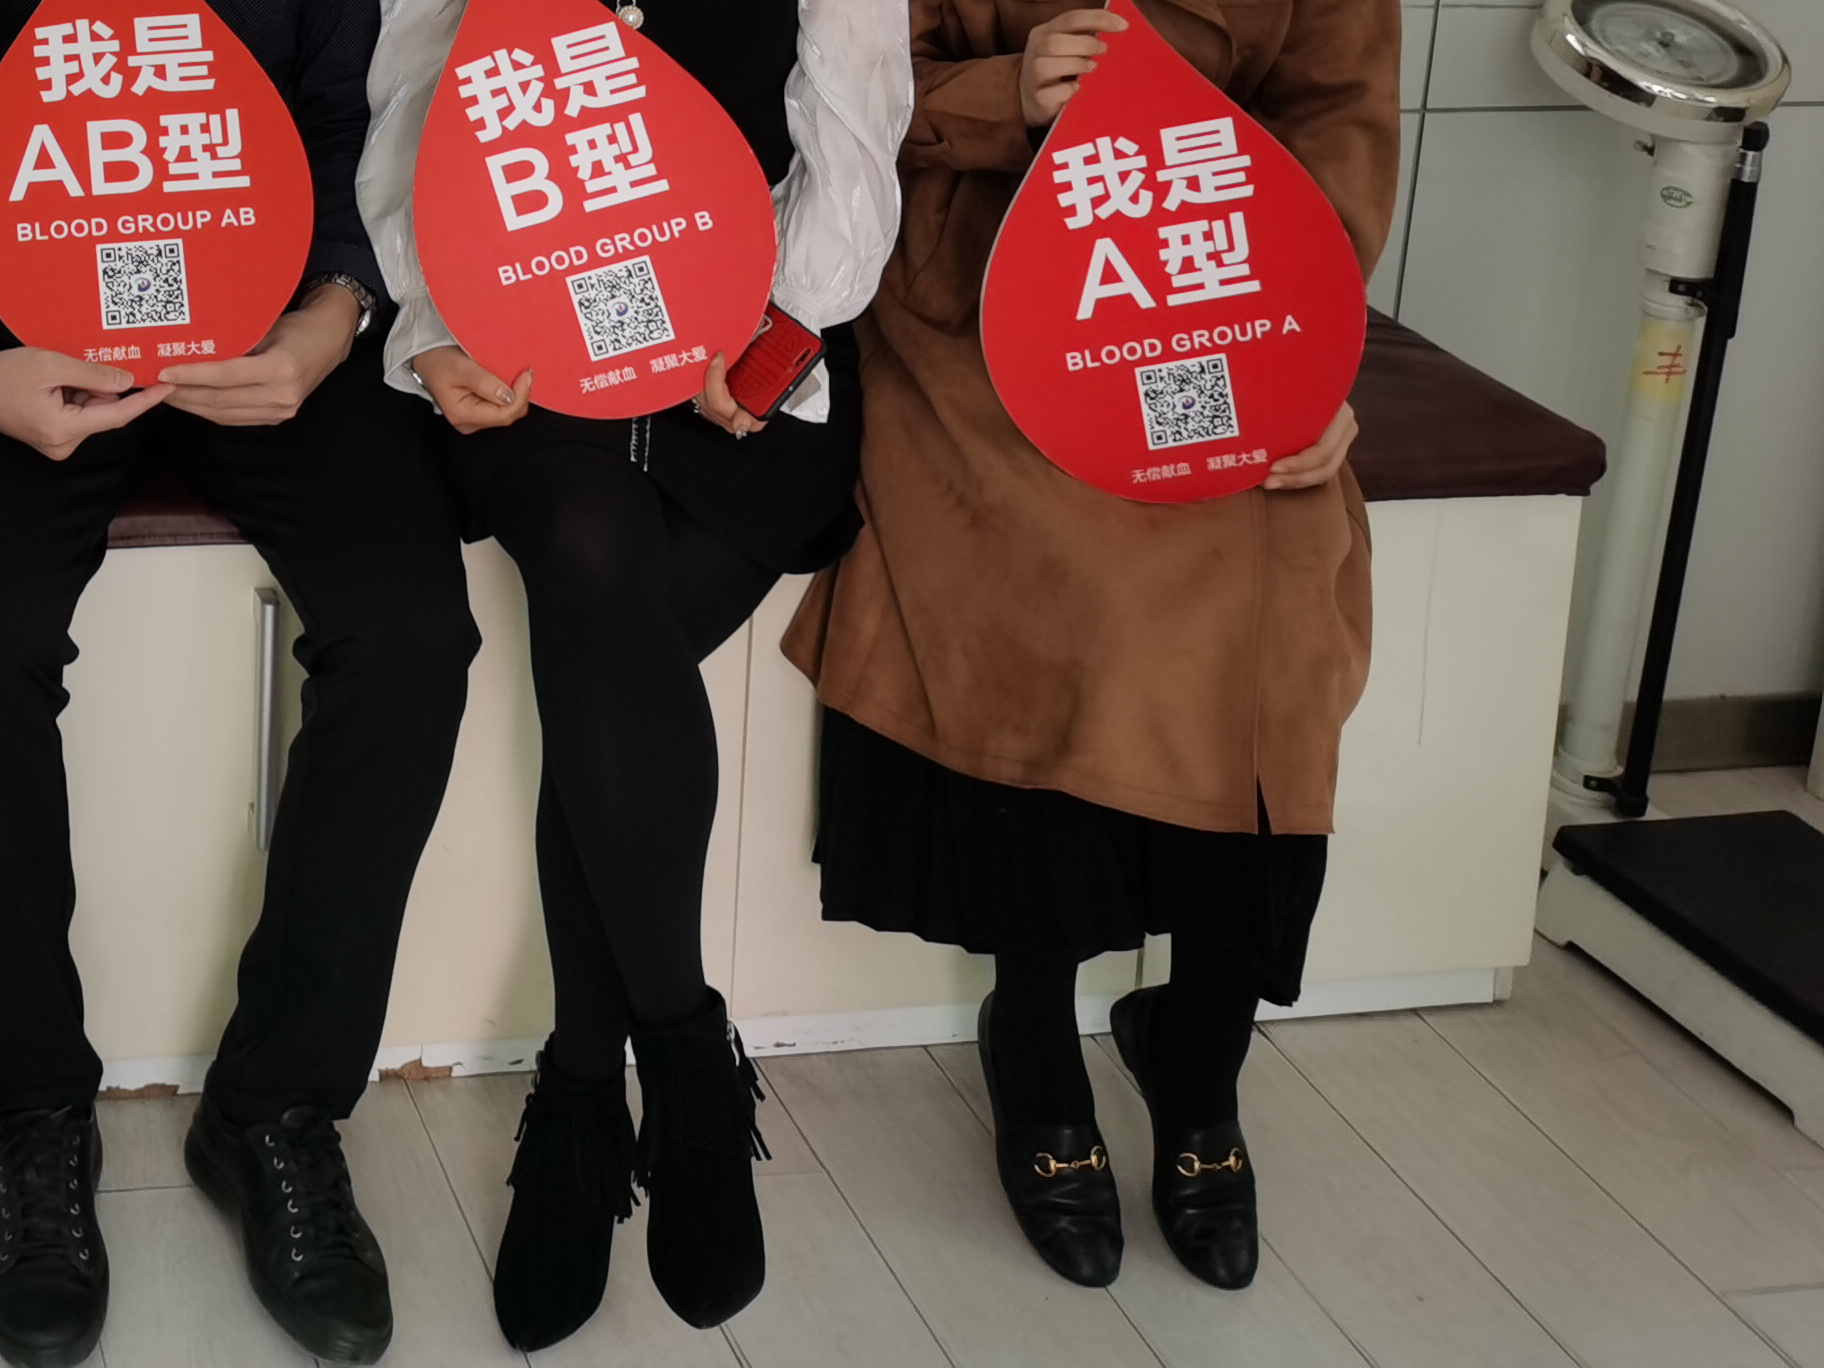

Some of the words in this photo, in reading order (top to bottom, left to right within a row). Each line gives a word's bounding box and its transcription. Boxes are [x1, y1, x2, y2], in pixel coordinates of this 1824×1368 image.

[32, 13, 216, 103] 我是
[454, 21, 647, 144] 我是
[8, 108, 251, 202] AB型
[1052, 116, 1255, 230] 我是
[16, 216, 109, 242] BLOOD
[116, 209, 212, 235] GROUP
[220, 207, 257, 228] AB
[496, 245, 589, 286] BLOOD
[595, 218, 688, 259] GROUP
[694, 211, 714, 231] B
[82, 344, 142, 363] 无偿献血
[156, 338, 217, 357] 凝聚大爱
[579, 364, 638, 394] 无偿献血
[649, 345, 709, 374] 凝聚大爱
[1065, 337, 1163, 372] BLOOD
[1170, 318, 1272, 353] GROUP
[1281, 314, 1302, 335] A
[1130, 460, 1192, 485] 无偿献血
[1206, 448, 1268, 472] 凝聚大爱
